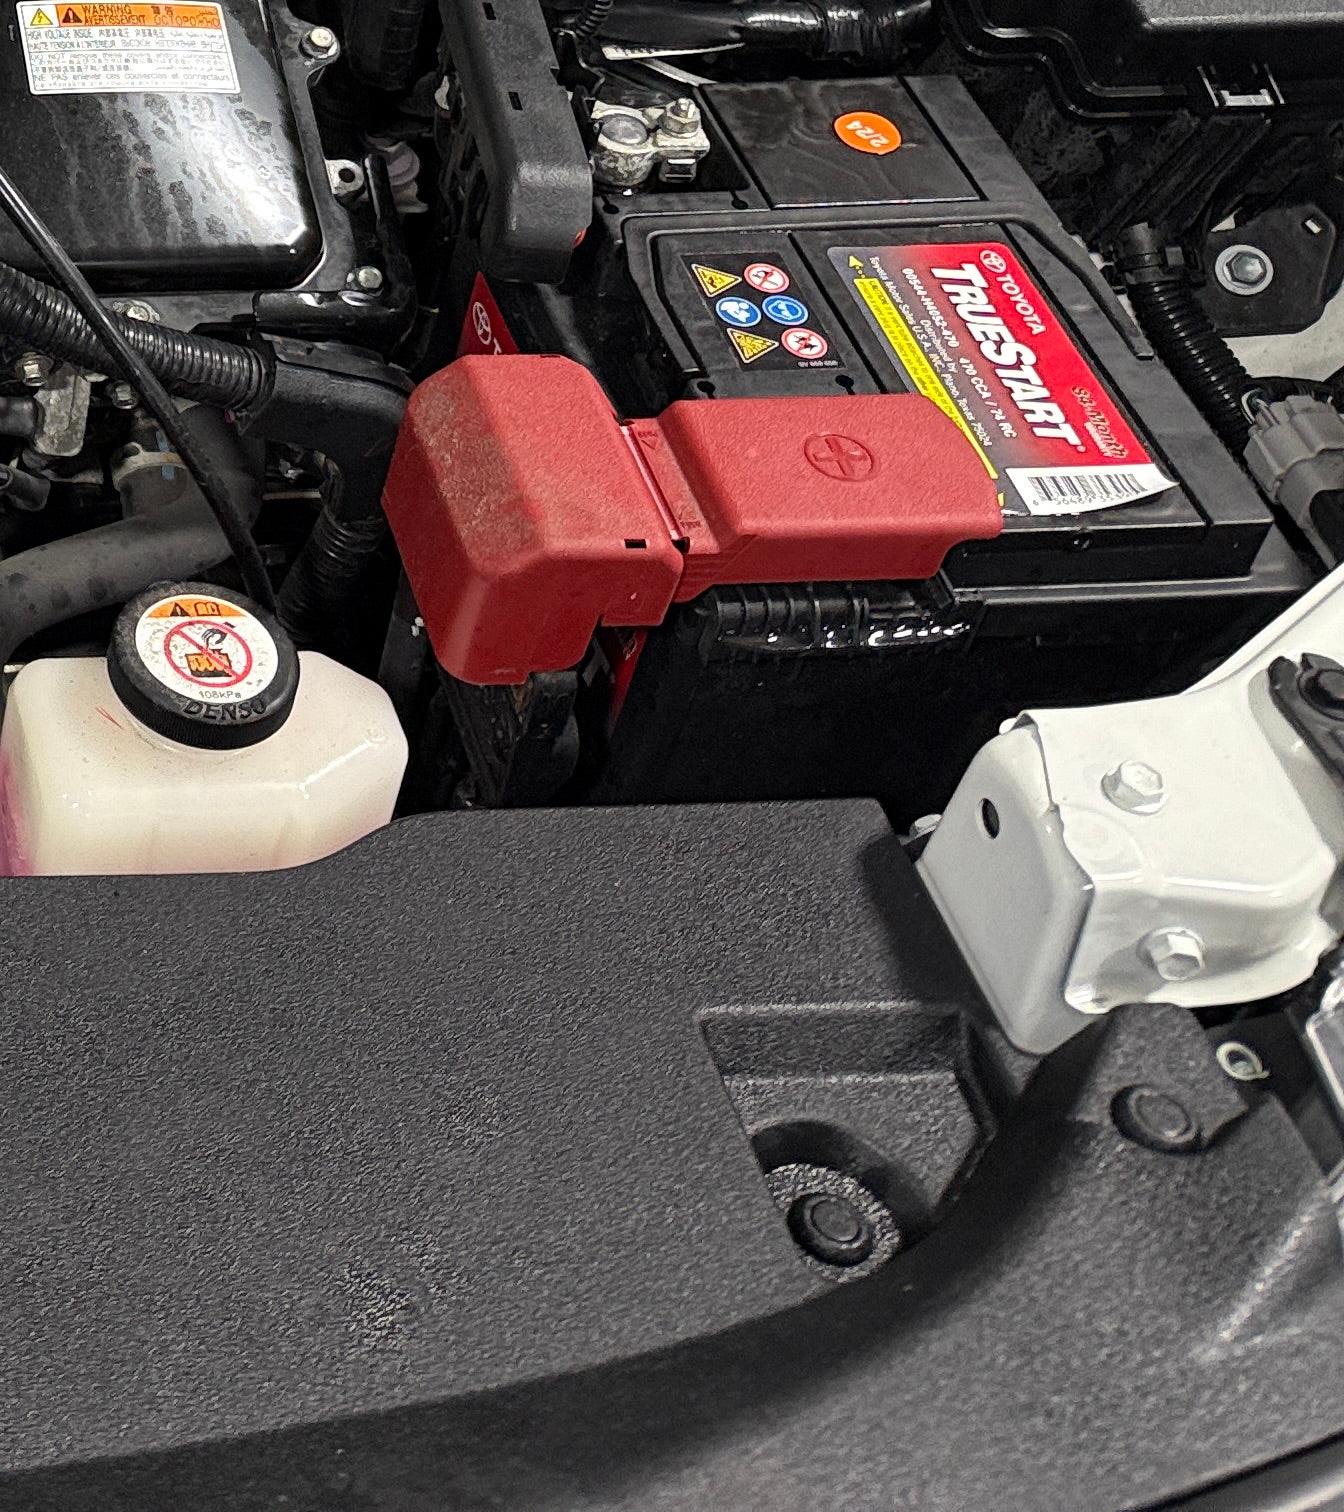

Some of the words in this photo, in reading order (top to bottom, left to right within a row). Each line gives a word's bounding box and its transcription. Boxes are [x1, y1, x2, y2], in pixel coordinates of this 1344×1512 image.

[82, 5, 132, 15] WARNING
[84, 15, 145, 25] AVERTISSEMENT
[996, 274, 1046, 335] TOYOTA
[869, 256, 888, 281] Toyota
[885, 280, 903, 304] Motor
[899, 303, 916, 327] Sales
[957, 398, 976, 422] Texas
[920, 320, 952, 362] Distributed
[947, 361, 959, 375] by
[959, 358, 977, 376] 470
[971, 377, 992, 401] CCA
[999, 422, 1017, 439] RC
[183, 698, 267, 722] DENSO
[198, 689, 242, 700] 108kPa
